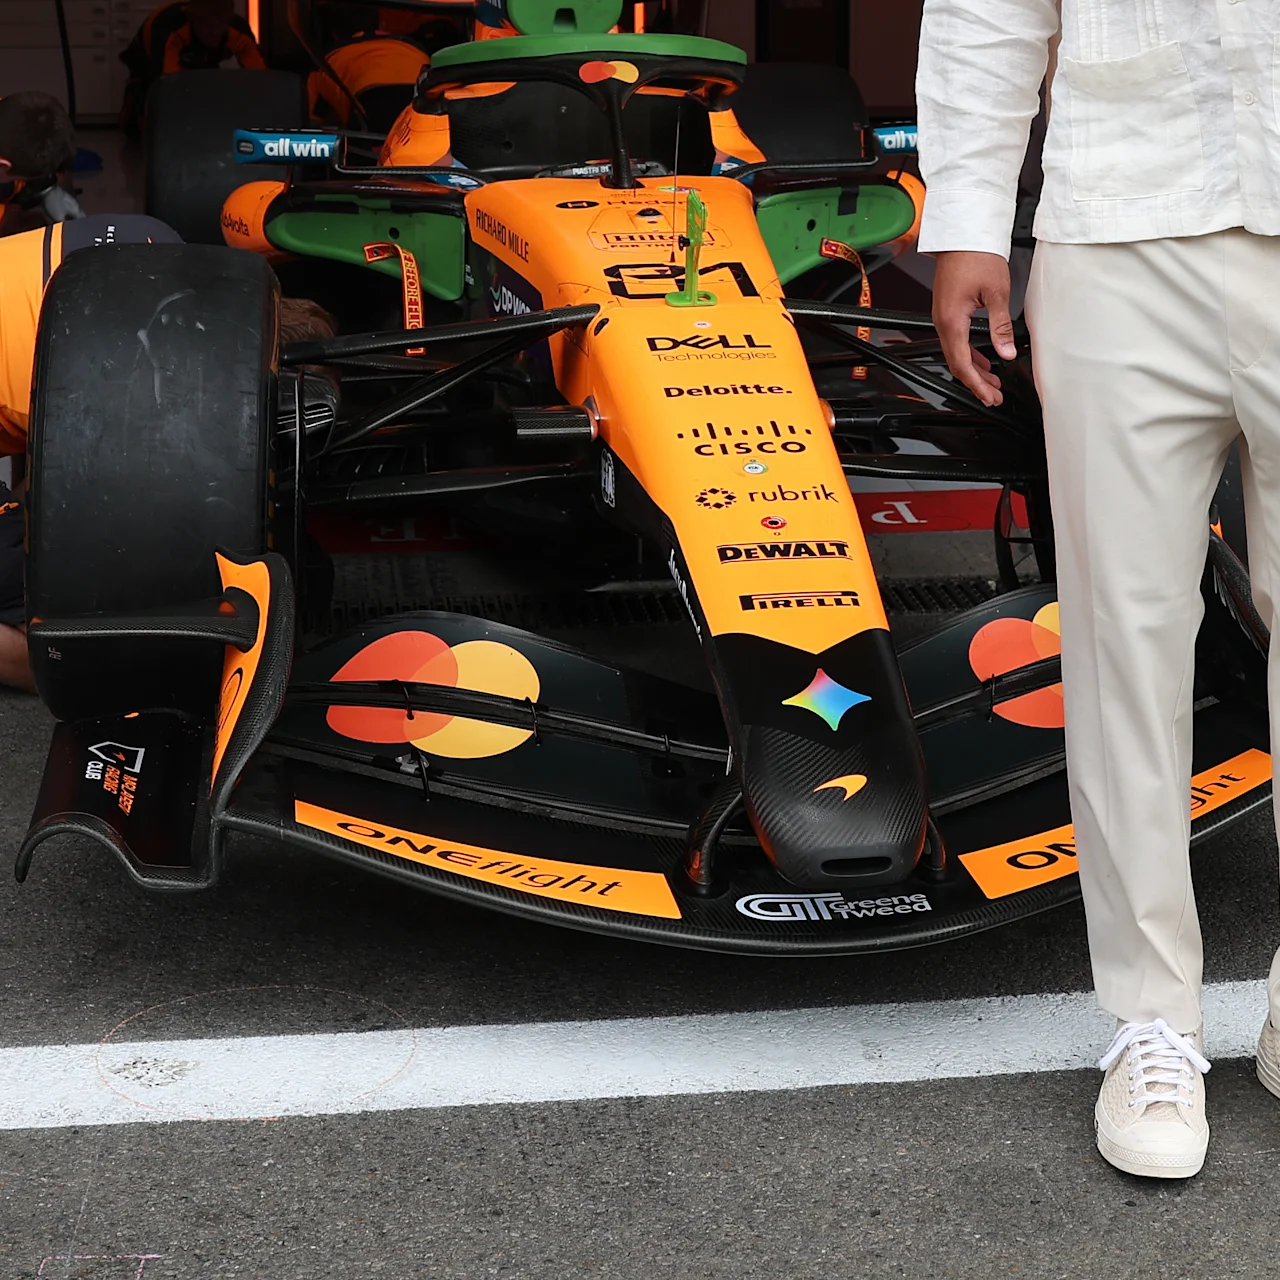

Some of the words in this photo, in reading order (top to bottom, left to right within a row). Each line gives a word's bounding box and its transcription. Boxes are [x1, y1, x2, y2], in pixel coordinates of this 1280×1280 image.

[572, 166, 600, 176] PIASTRI
[475, 208, 507, 246] RICHARD
[507, 229, 530, 264] MILLE
[603, 261, 761, 300] 81
[646, 334, 773, 352] DELL
[651, 351, 778, 362] Technologies
[748, 483, 840, 504] rubrik
[738, 590, 861, 611] PIRELLI
[84, 760, 105, 781] CLUB
[102, 763, 121, 795] RACING
[828, 893, 927, 911] Greene
[833, 899, 932, 920] Tweed
